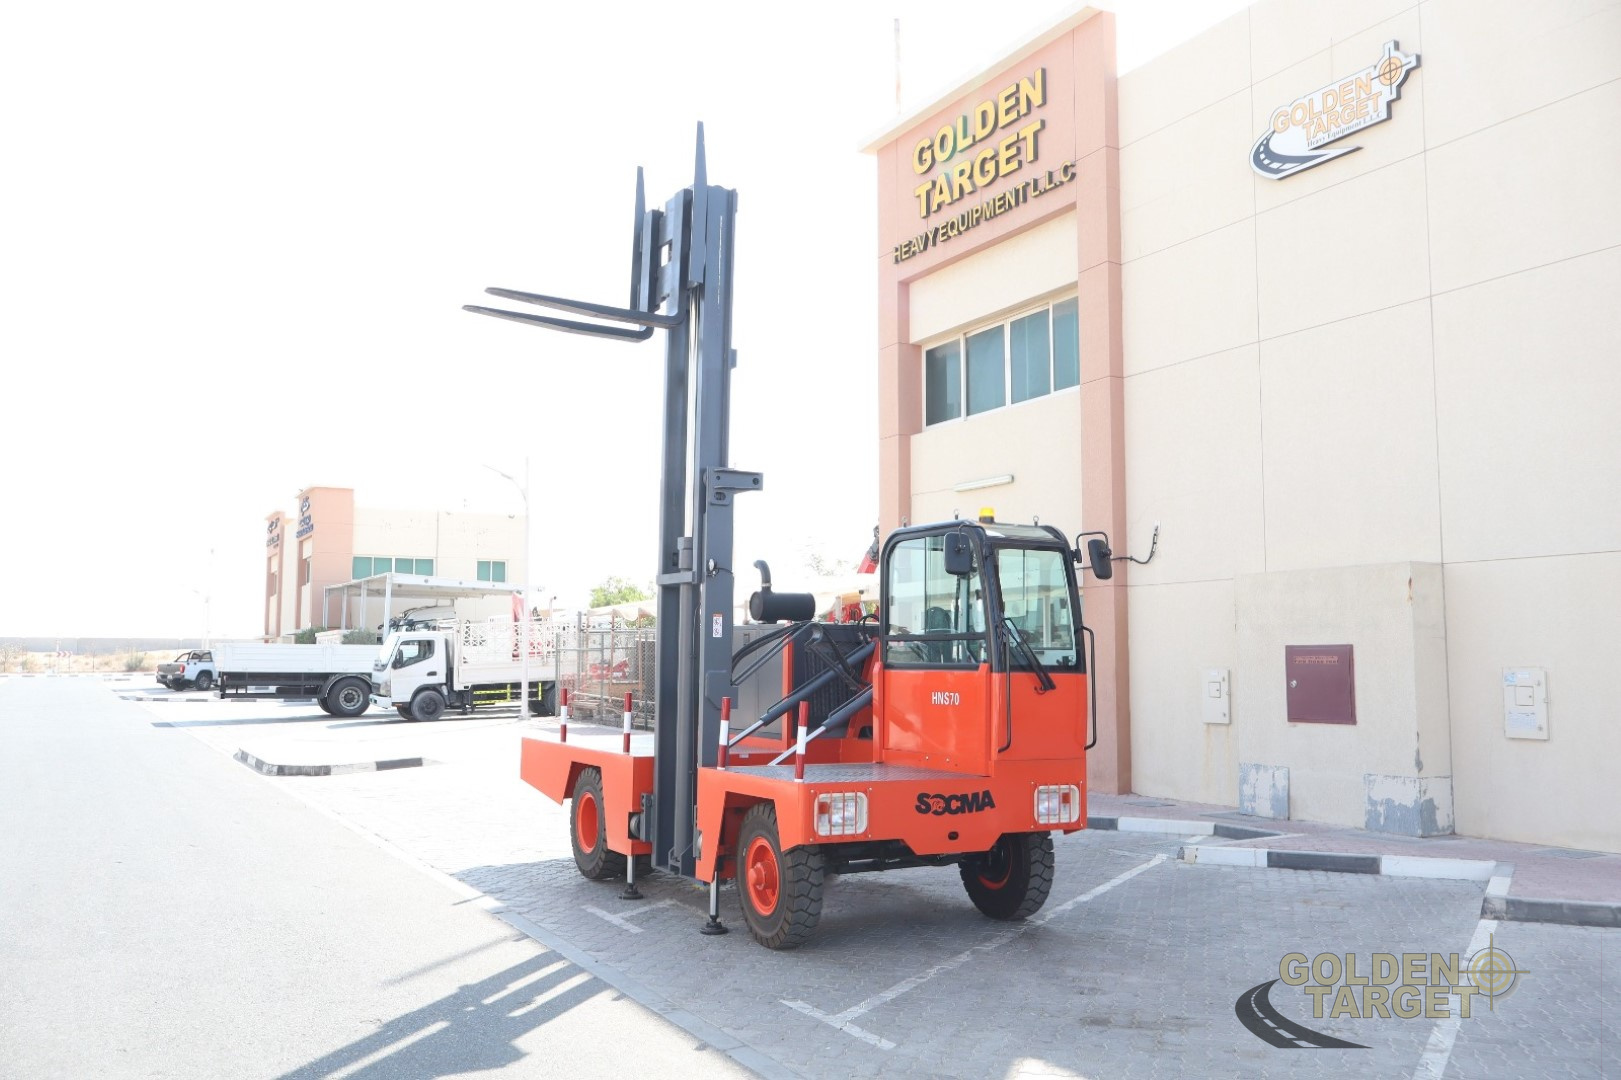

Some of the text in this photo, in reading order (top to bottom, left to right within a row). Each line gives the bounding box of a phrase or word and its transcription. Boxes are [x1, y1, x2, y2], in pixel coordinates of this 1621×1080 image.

[912, 67, 1046, 175] GOLDEN
[1273, 72, 1373, 134] GOLDEN
[1302, 91, 1382, 142] TARGET
[1307, 135, 1327, 148] Heavy
[1327, 121, 1362, 139] Equipment
[914, 119, 1045, 219] TARGET
[893, 160, 1077, 264] HEAVY EQUIPMENT L.L.C
[931, 691, 960, 706] HNS70
[915, 789, 996, 816] SOCMA
